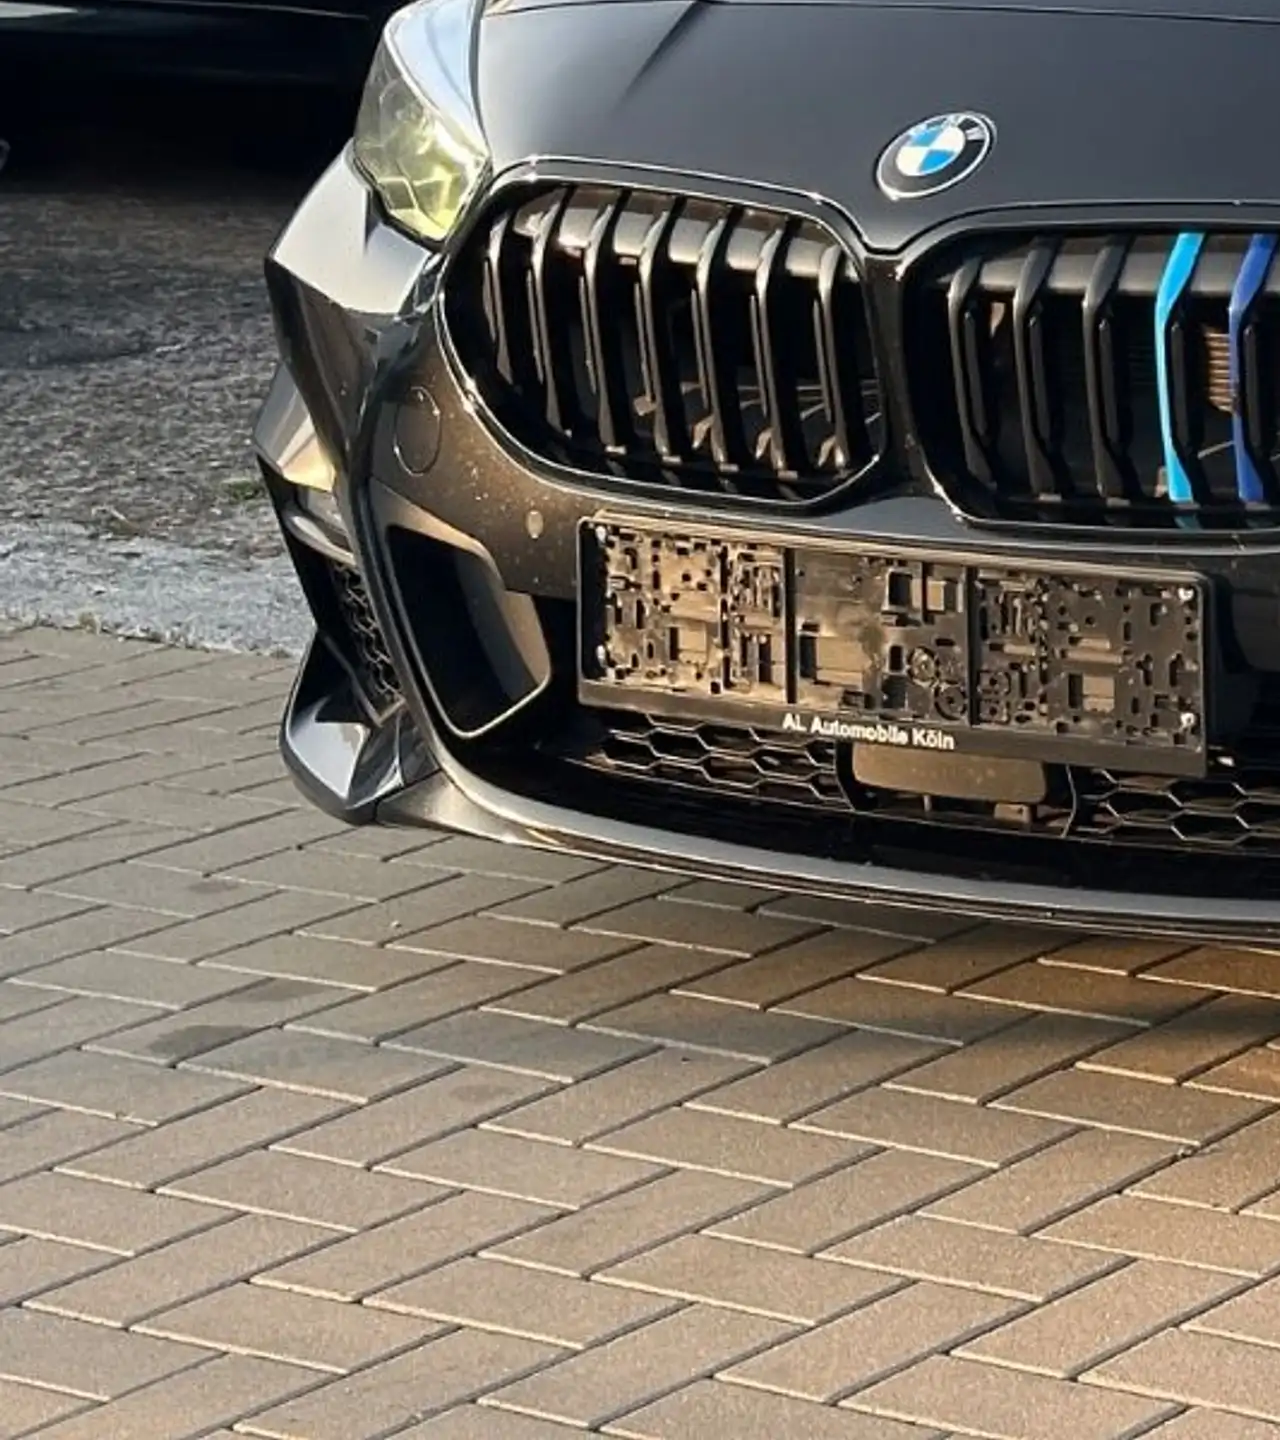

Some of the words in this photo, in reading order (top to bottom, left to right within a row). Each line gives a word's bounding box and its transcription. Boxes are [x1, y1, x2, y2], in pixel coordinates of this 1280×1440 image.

[781, 712, 808, 732] AL
[810, 716, 909, 745] Automobile
[912, 728, 956, 751] Köln
